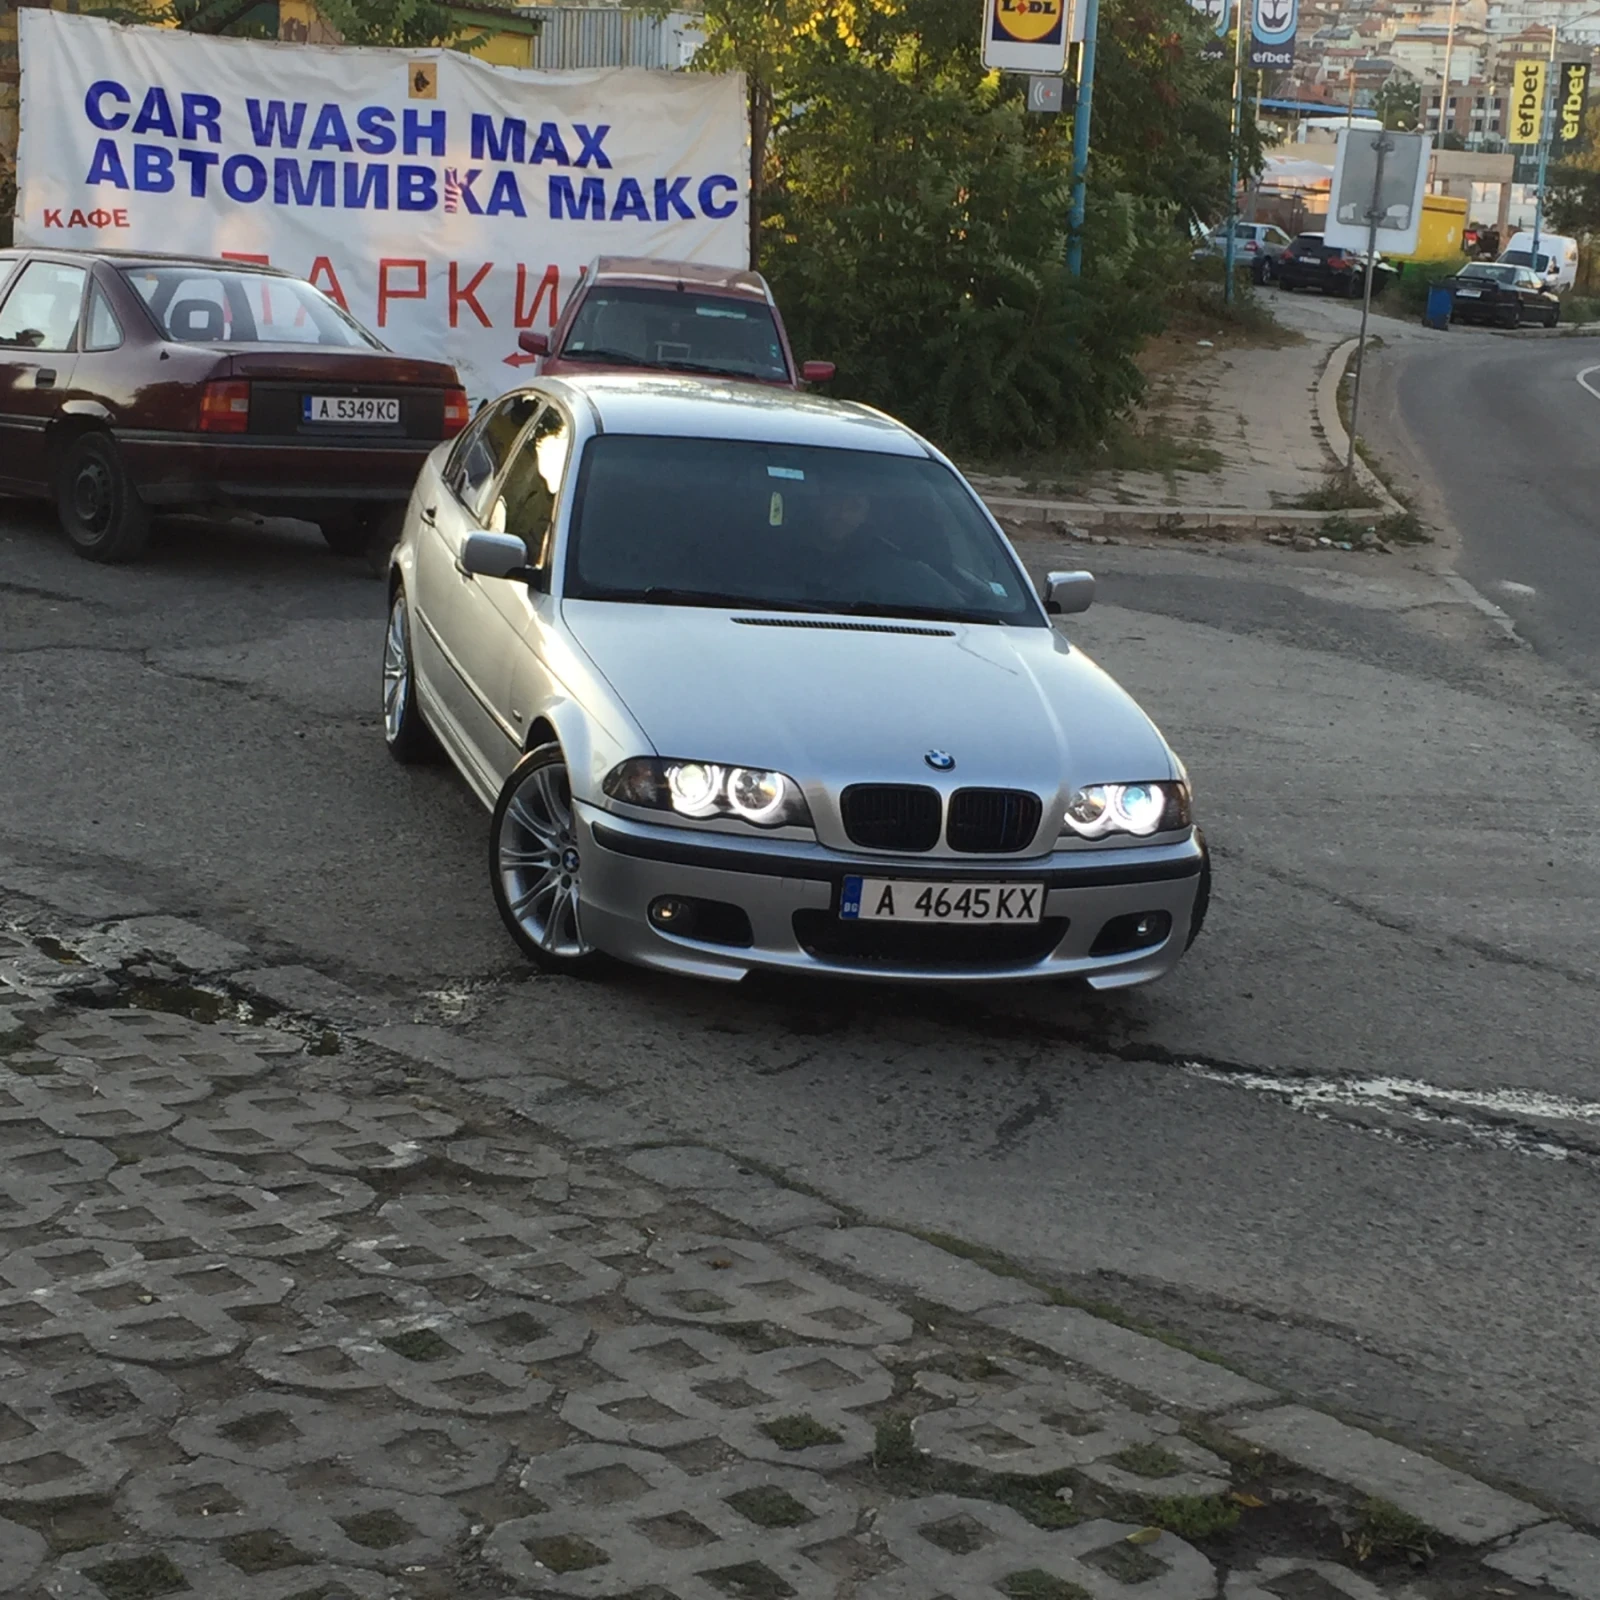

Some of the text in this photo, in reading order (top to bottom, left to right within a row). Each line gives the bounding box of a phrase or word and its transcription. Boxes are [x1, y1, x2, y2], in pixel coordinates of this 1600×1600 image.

[1252, 52, 1291, 63] efbet
[84, 80, 612, 170] CAR WASH MAX
[1518, 65, 1539, 139] efbet
[1560, 65, 1586, 141] efbet
[86, 138, 738, 222] АВТОМИВКА МАКС
[43, 208, 130, 229] КАФЕ
